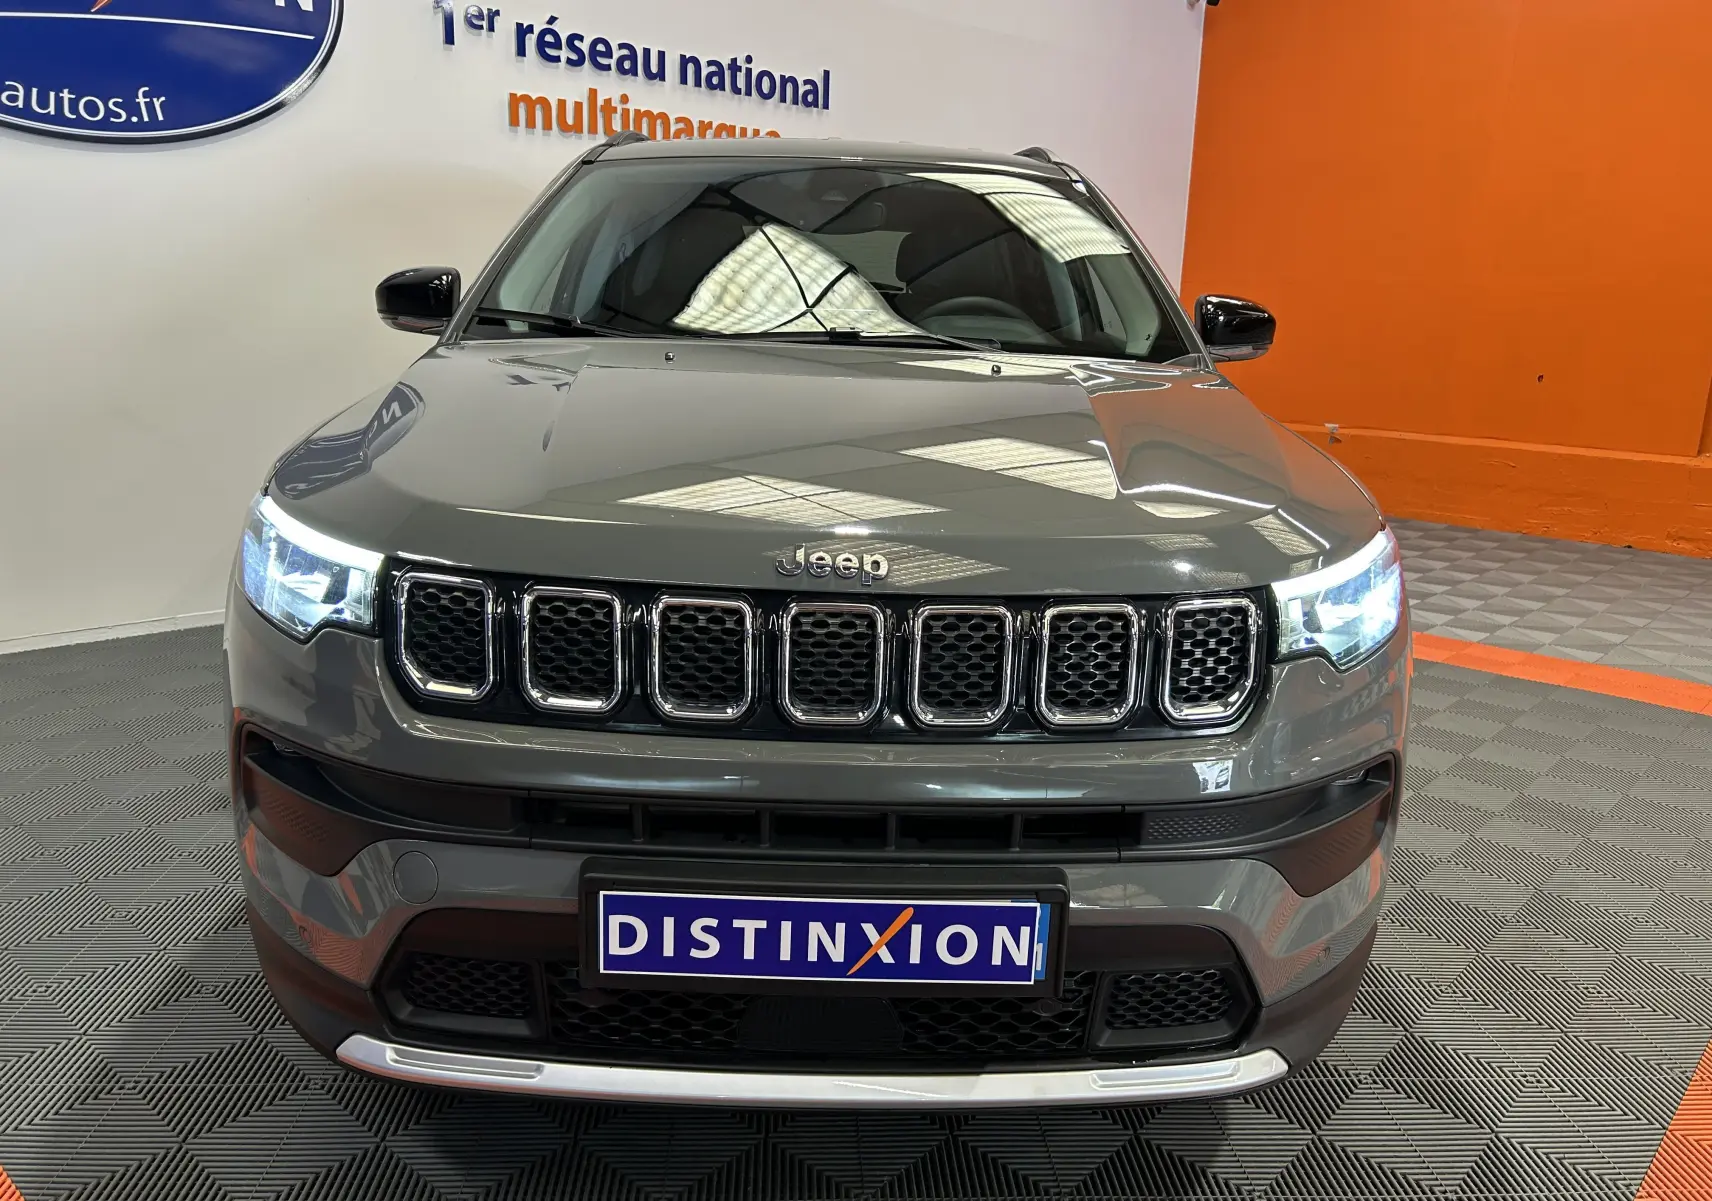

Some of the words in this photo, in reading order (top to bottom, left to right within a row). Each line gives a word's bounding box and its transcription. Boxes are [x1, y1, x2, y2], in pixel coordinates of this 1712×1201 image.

[515, 15, 666, 82] réseau
[679, 52, 831, 110] national
[509, 88, 781, 140] multimar
[775, 543, 889, 586] Jeep
[608, 907, 1031, 976] DISTINXION
